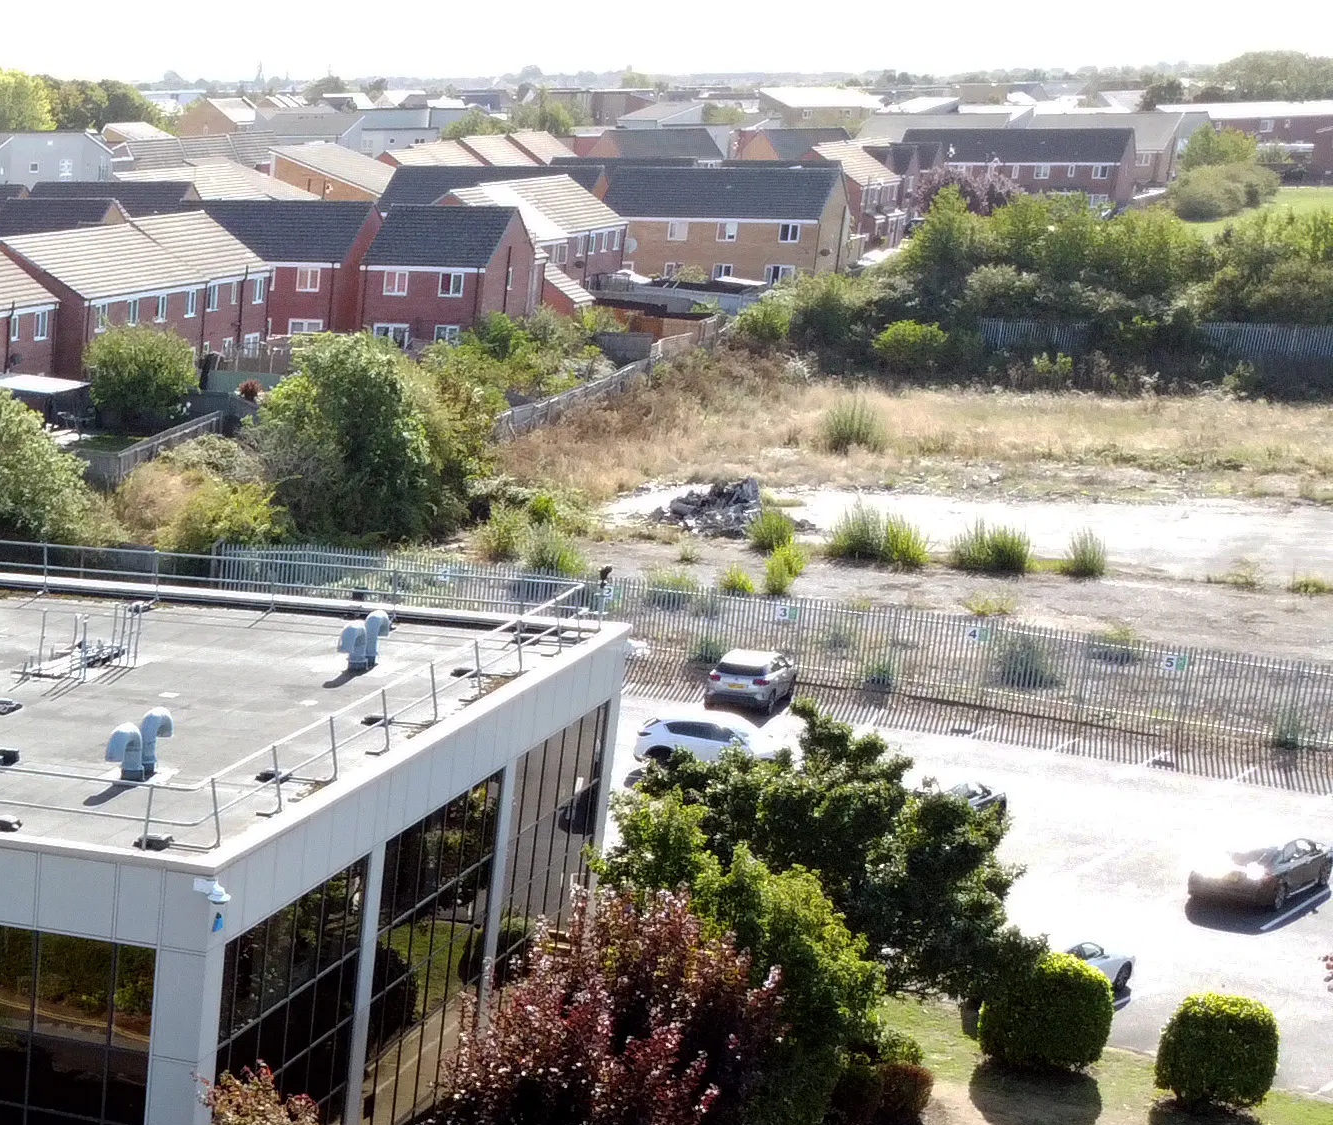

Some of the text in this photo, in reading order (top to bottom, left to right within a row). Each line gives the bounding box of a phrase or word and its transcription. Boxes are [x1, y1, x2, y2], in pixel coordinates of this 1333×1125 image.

[779, 607, 787, 618] 3
[968, 629, 977, 639] 4
[1165, 657, 1174, 668] 5
